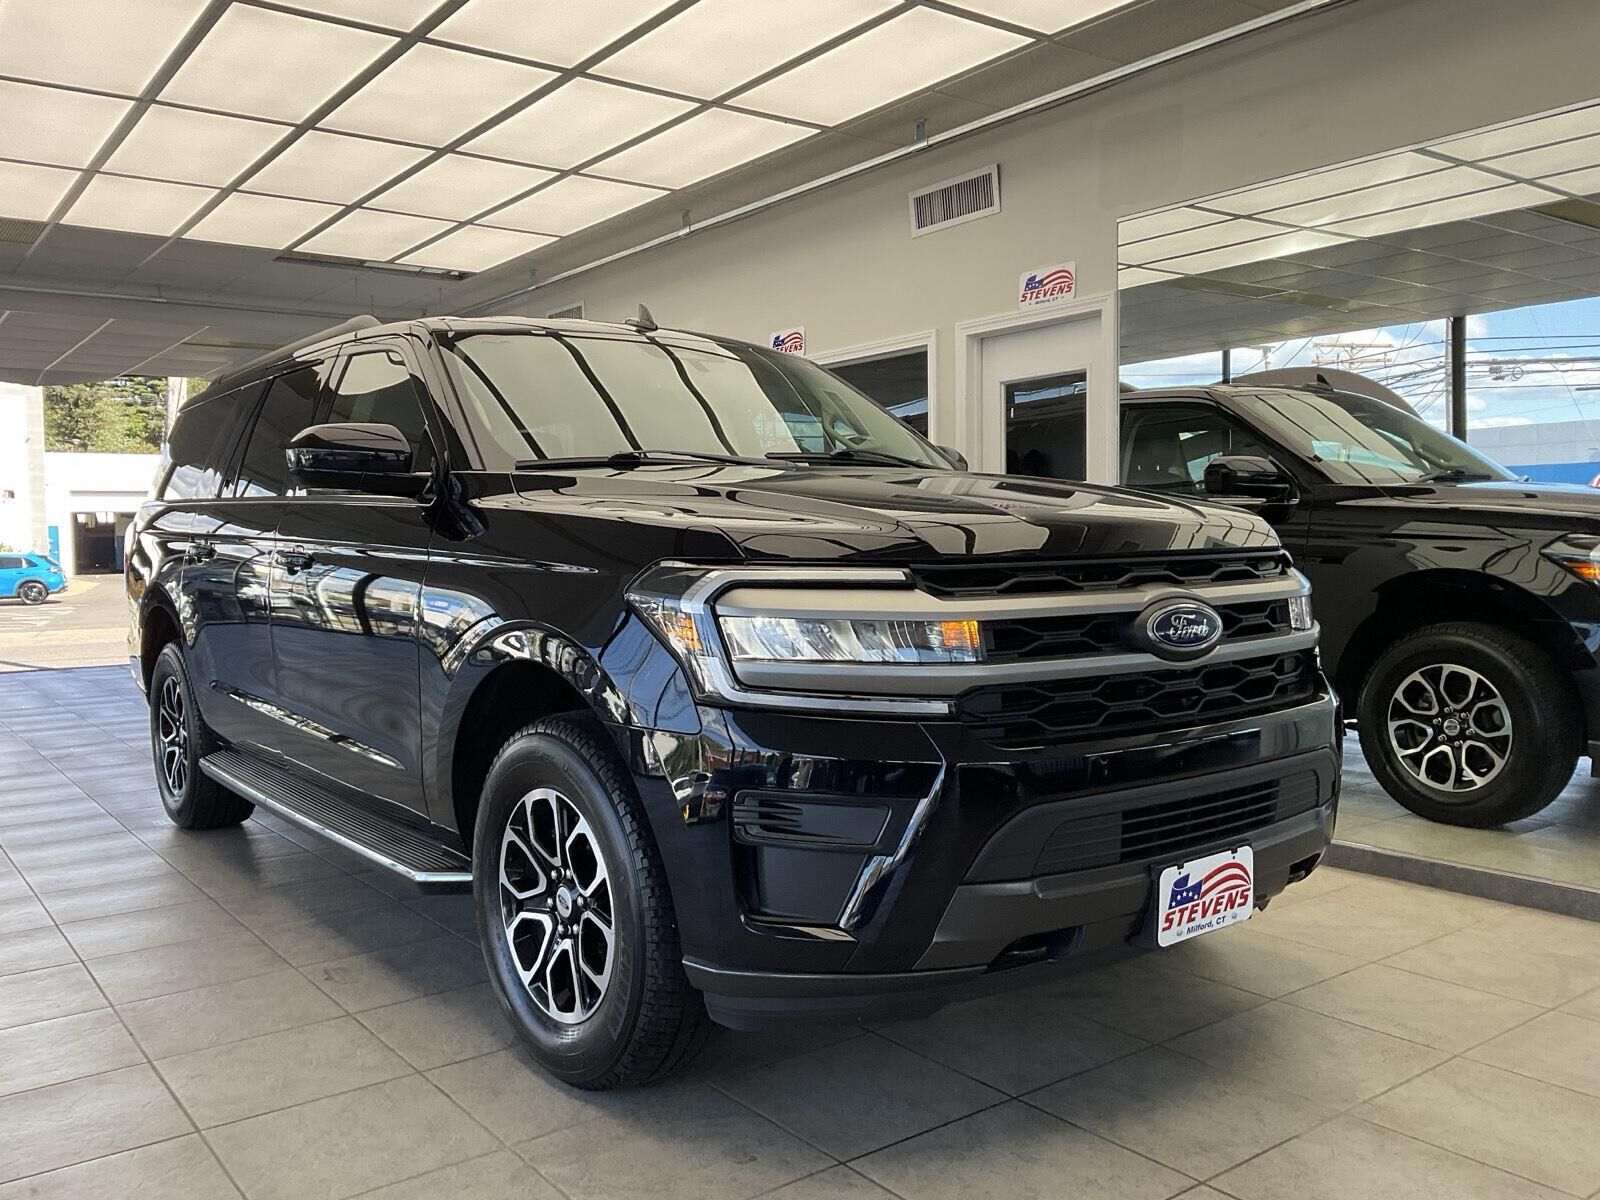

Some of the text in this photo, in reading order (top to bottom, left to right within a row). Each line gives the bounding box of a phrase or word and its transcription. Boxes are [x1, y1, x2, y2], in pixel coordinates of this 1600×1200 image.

[1020, 283, 1073, 302] STEVENS
[776, 343, 803, 353] EVENS
[1168, 613, 1210, 640] Ford
[1161, 887, 1251, 932] STEVENS
[1186, 915, 1227, 935] Milford, CT
